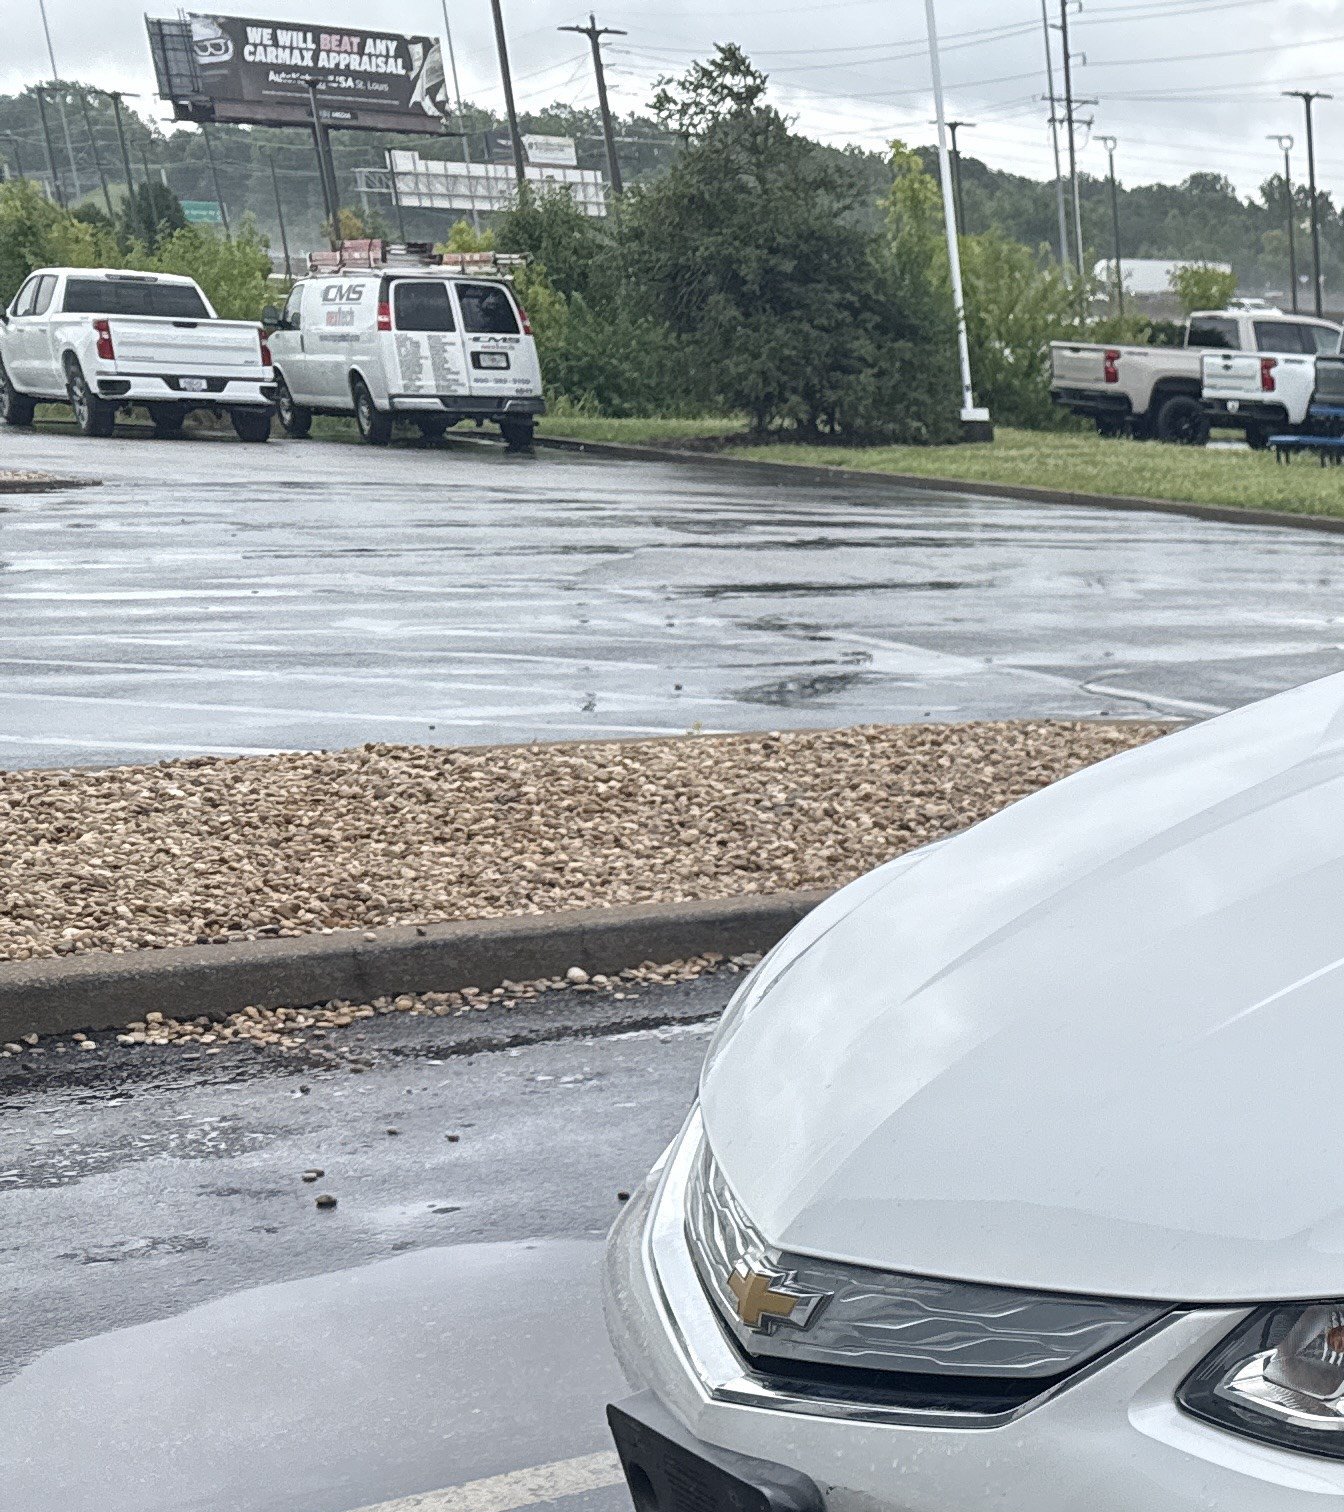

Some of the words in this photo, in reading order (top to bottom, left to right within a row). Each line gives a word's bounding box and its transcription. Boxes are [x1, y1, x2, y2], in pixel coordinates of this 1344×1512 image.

[246, 26, 273, 46] WE
[276, 29, 316, 51] WILL
[320, 33, 360, 53] BEAT
[363, 38, 398, 57] ANY
[243, 45, 313, 68] CARMAX
[318, 52, 406, 76] APPRAISAL
[321, 283, 365, 302] CMS
